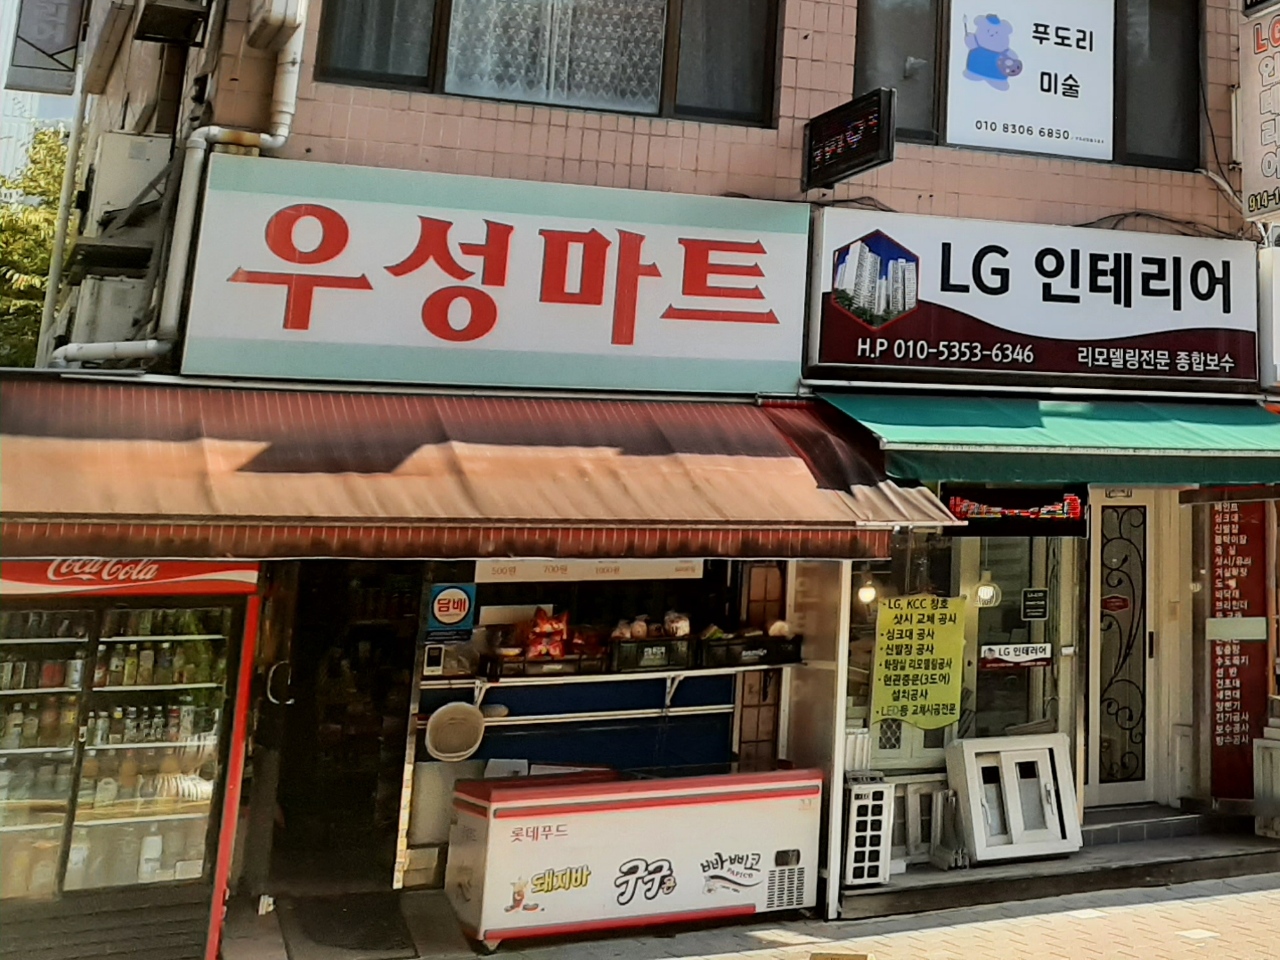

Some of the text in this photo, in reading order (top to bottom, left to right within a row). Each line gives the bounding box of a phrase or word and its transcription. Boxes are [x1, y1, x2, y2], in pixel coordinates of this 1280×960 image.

[1032, 22, 1094, 52] 푸도리
[1039, 71, 1080, 99] 미술
[975, 120, 997, 132] 010
[1002, 123, 1034, 136] 8306
[1038, 127, 1070, 141] 6850
[226, 202, 780, 346] 우성마트
[939, 241, 1231, 314] LG 인테리어
[857, 338, 1034, 364] H.P 010-5353-6346
[1175, 350, 1235, 372] 종합보수
[437, 597, 467, 613] 담배
[906, 599, 928, 610] KCC
[938, 612, 957, 626] 공사
[886, 628, 936, 641] 싱크대 공사
[916, 643, 936, 656] 공사
[998, 646, 1047, 658] LG 인테리어
[884, 659, 907, 672] 화장실
[510, 823, 569, 843] 롯데푸드
[700, 851, 762, 875] 빠삐코
[530, 865, 591, 895] 돼지바
